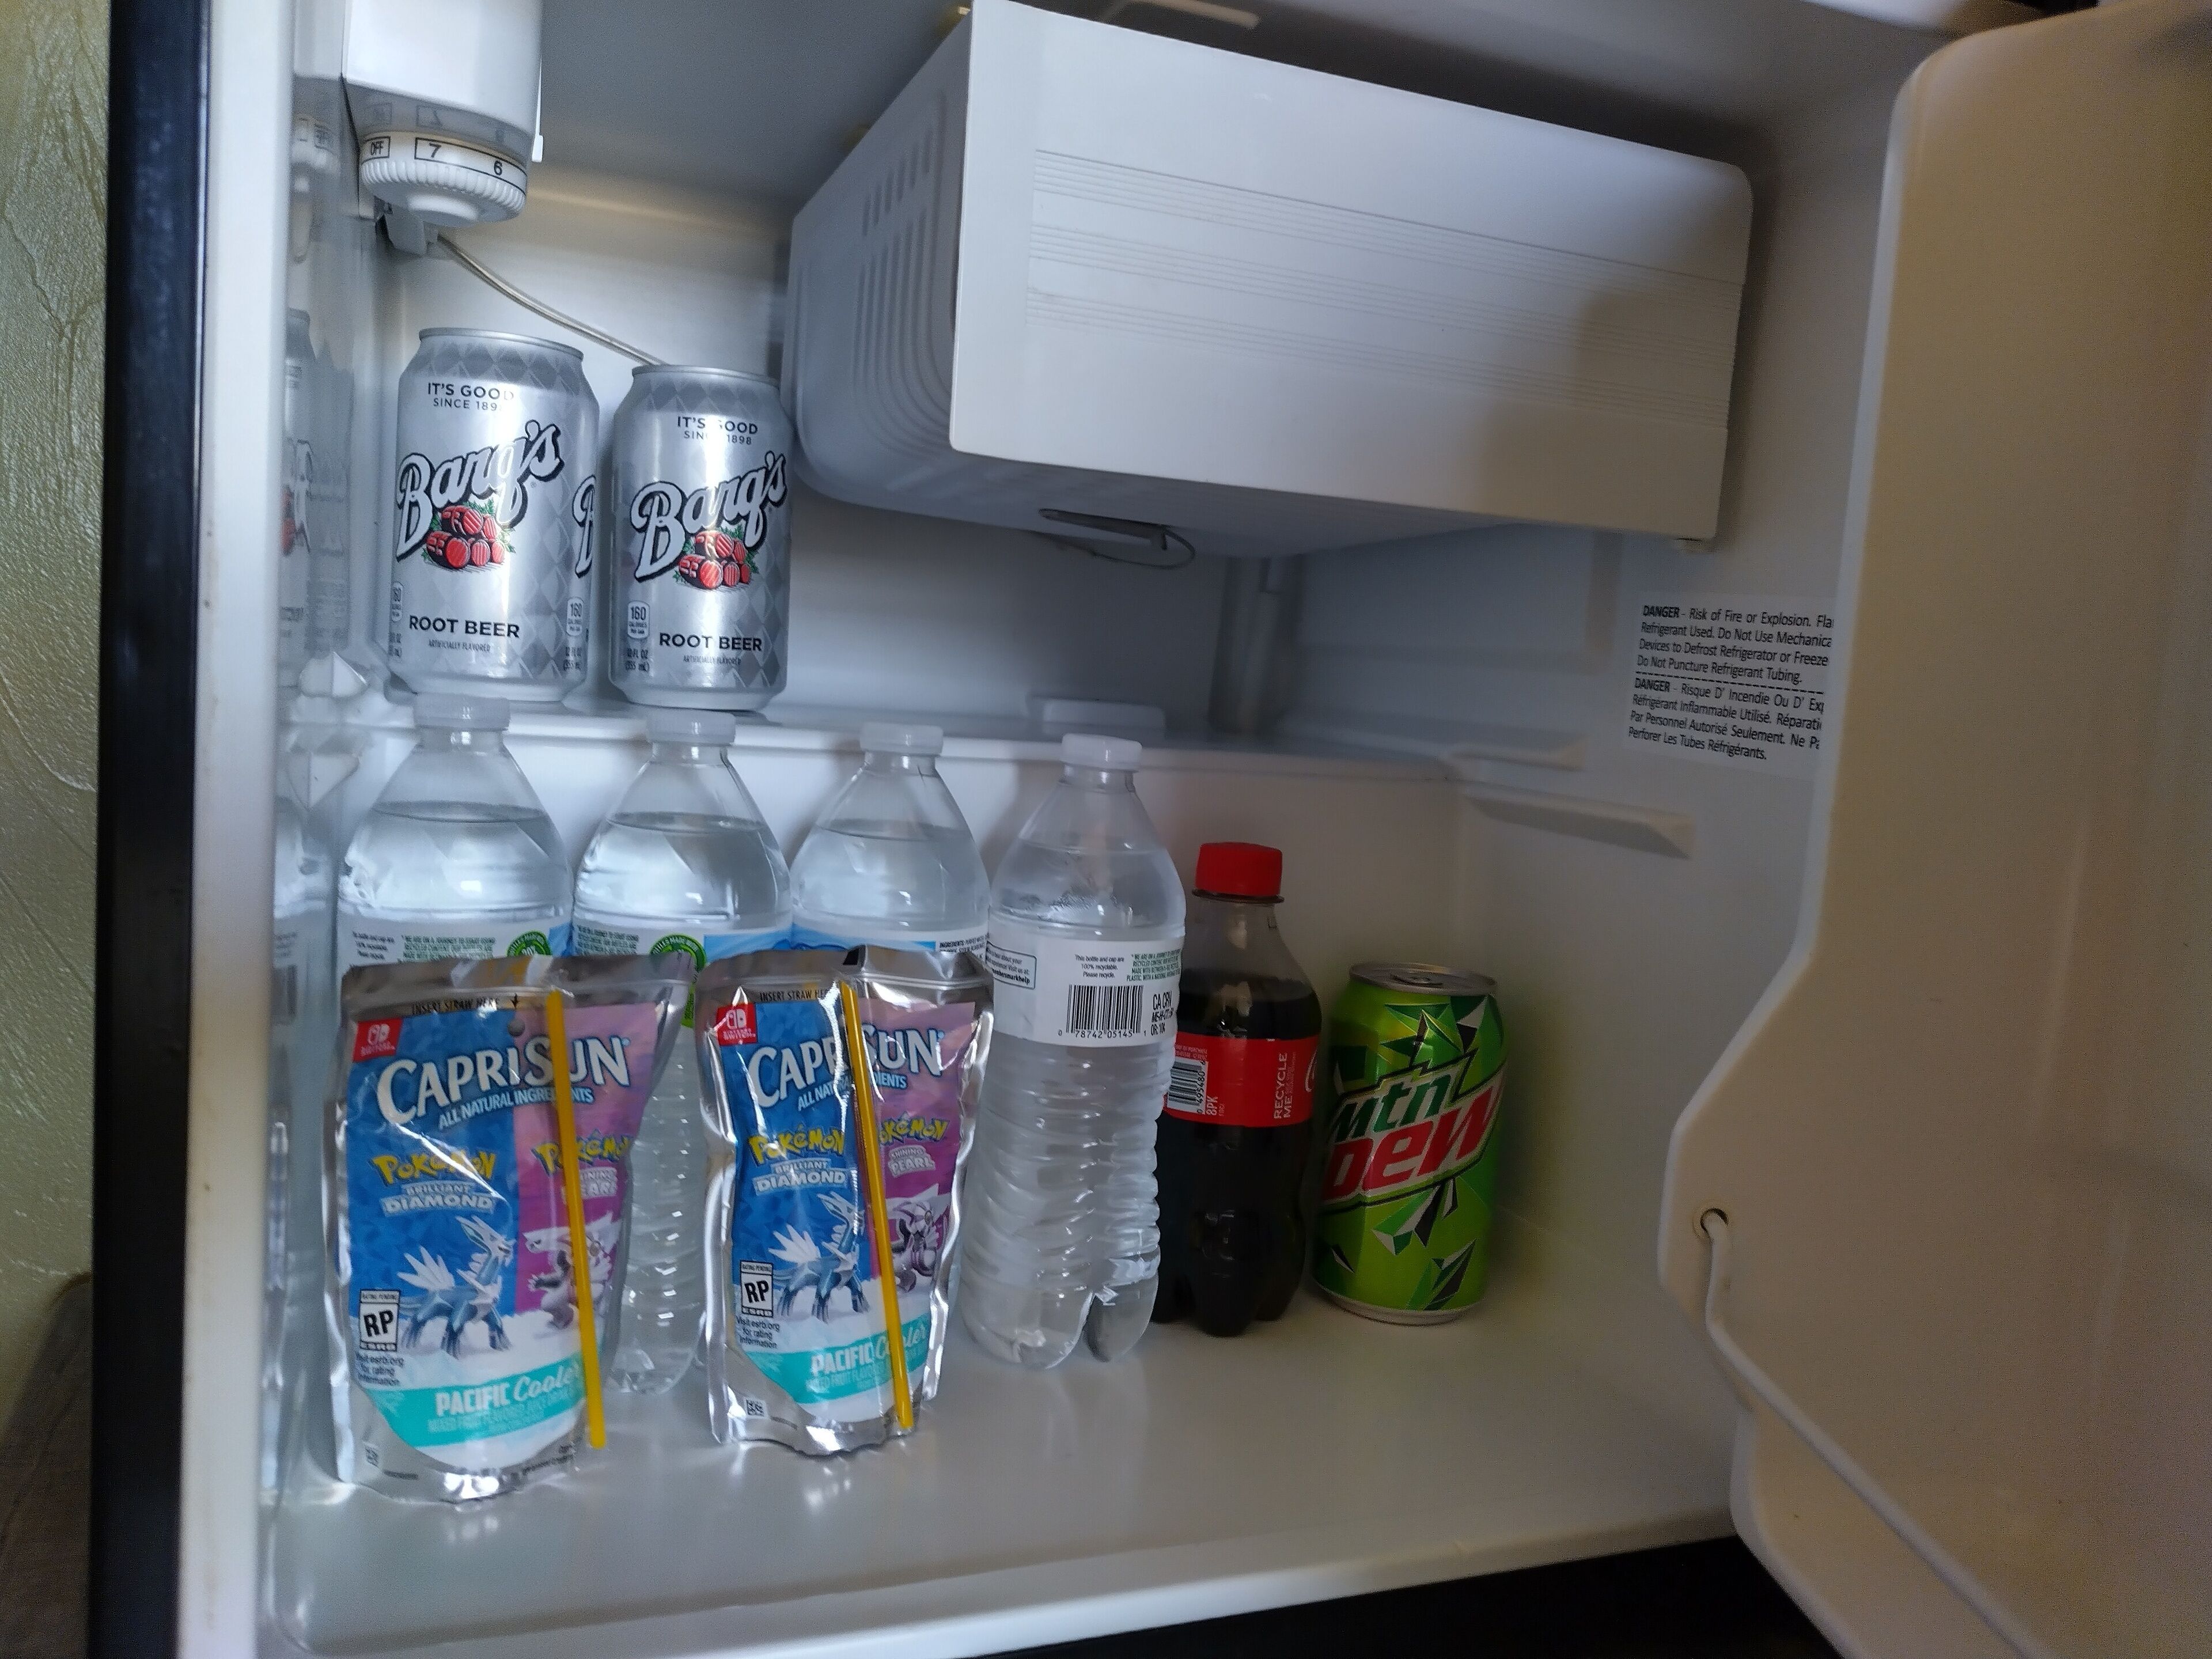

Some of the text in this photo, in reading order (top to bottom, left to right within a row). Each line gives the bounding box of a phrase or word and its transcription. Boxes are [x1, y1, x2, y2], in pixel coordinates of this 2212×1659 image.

[429, 143, 503, 176] 7 6
[428, 382, 514, 400] IT'S GOOD
[433, 397, 500, 412] SINCE 189
[677, 416, 758, 435] IT'S OOD
[684, 430, 752, 446] SIN 1898
[396, 419, 565, 563] Barq's
[630, 450, 787, 583] Barq's
[631, 606, 646, 620] 160
[1643, 605, 1834, 628] DANGER Risk of Fire or Explosion. Fla
[409, 615, 520, 639] ROOT BEER
[1641, 622, 1687, 637] Refrigerant
[1690, 626, 1714, 638] Used.
[1718, 627, 1732, 640] Do
[1734, 628, 1752, 641] Not
[1755, 630, 1773, 643] Use
[659, 632, 762, 652] ROOT BEER
[1639, 638, 1671, 652] Devices
[1672, 641, 1681, 653] to
[1684, 642, 1718, 657] Defrost
[1720, 644, 1777, 662] Refrigerator
[1779, 653, 1791, 663] or
[1637, 654, 1802, 685] Do Not Puncture Refrigerant Tubing.
[1635, 677, 1671, 692] DANGER
[1681, 683, 1711, 699] Risque
[1728, 689, 1770, 705] Incendie
[1774, 694, 1789, 707] Ou
[1680, 700, 1737, 719] Inflammable
[1777, 712, 1822, 730] Réparati
[1628, 726, 1661, 741] Perforer
[1664, 732, 1677, 745] Les
[1680, 734, 1705, 750] Tubes
[1631, 710, 1643, 722] Par
[1646, 712, 1687, 729] Personnel
[1689, 718, 1728, 736] Autorisé
[1730, 725, 1785, 745] Seulement.
[1790, 733, 1805, 747] Ne
[1012, 957, 1022, 966] your
[759, 991, 785, 1002] INSERT
[788, 990, 812, 1000] STRAW
[1153, 991, 1172, 1010] CA CRV
[1075, 1029, 1103, 1038] 78742
[1107, 1029, 1132, 1038] 05145
[1196, 1071, 1205, 1104] 495480
[1274, 1052, 1287, 1119] RECYCLE
[438, 1109, 461, 1130] ALL
[461, 1095, 514, 1120] NATURAL
[798, 1094, 815, 1112] ALL
[1206, 1096, 1218, 1115] 8PK
[1283, 1095, 1292, 1118] ME
[891, 1147, 923, 1158] SHINING
[775, 1160, 828, 1173] BRILLIANT
[890, 1157, 933, 1175] PEARL
[756, 1171, 846, 1192] DIAMOND
[384, 1194, 493, 1213] DIAMOND
[744, 1280, 769, 1303] RP
[363, 1310, 393, 1337] RP
[753, 1330, 772, 1340] rating
[811, 1341, 874, 1377] PACIFIC
[435, 1382, 510, 1417] PACIFIC
